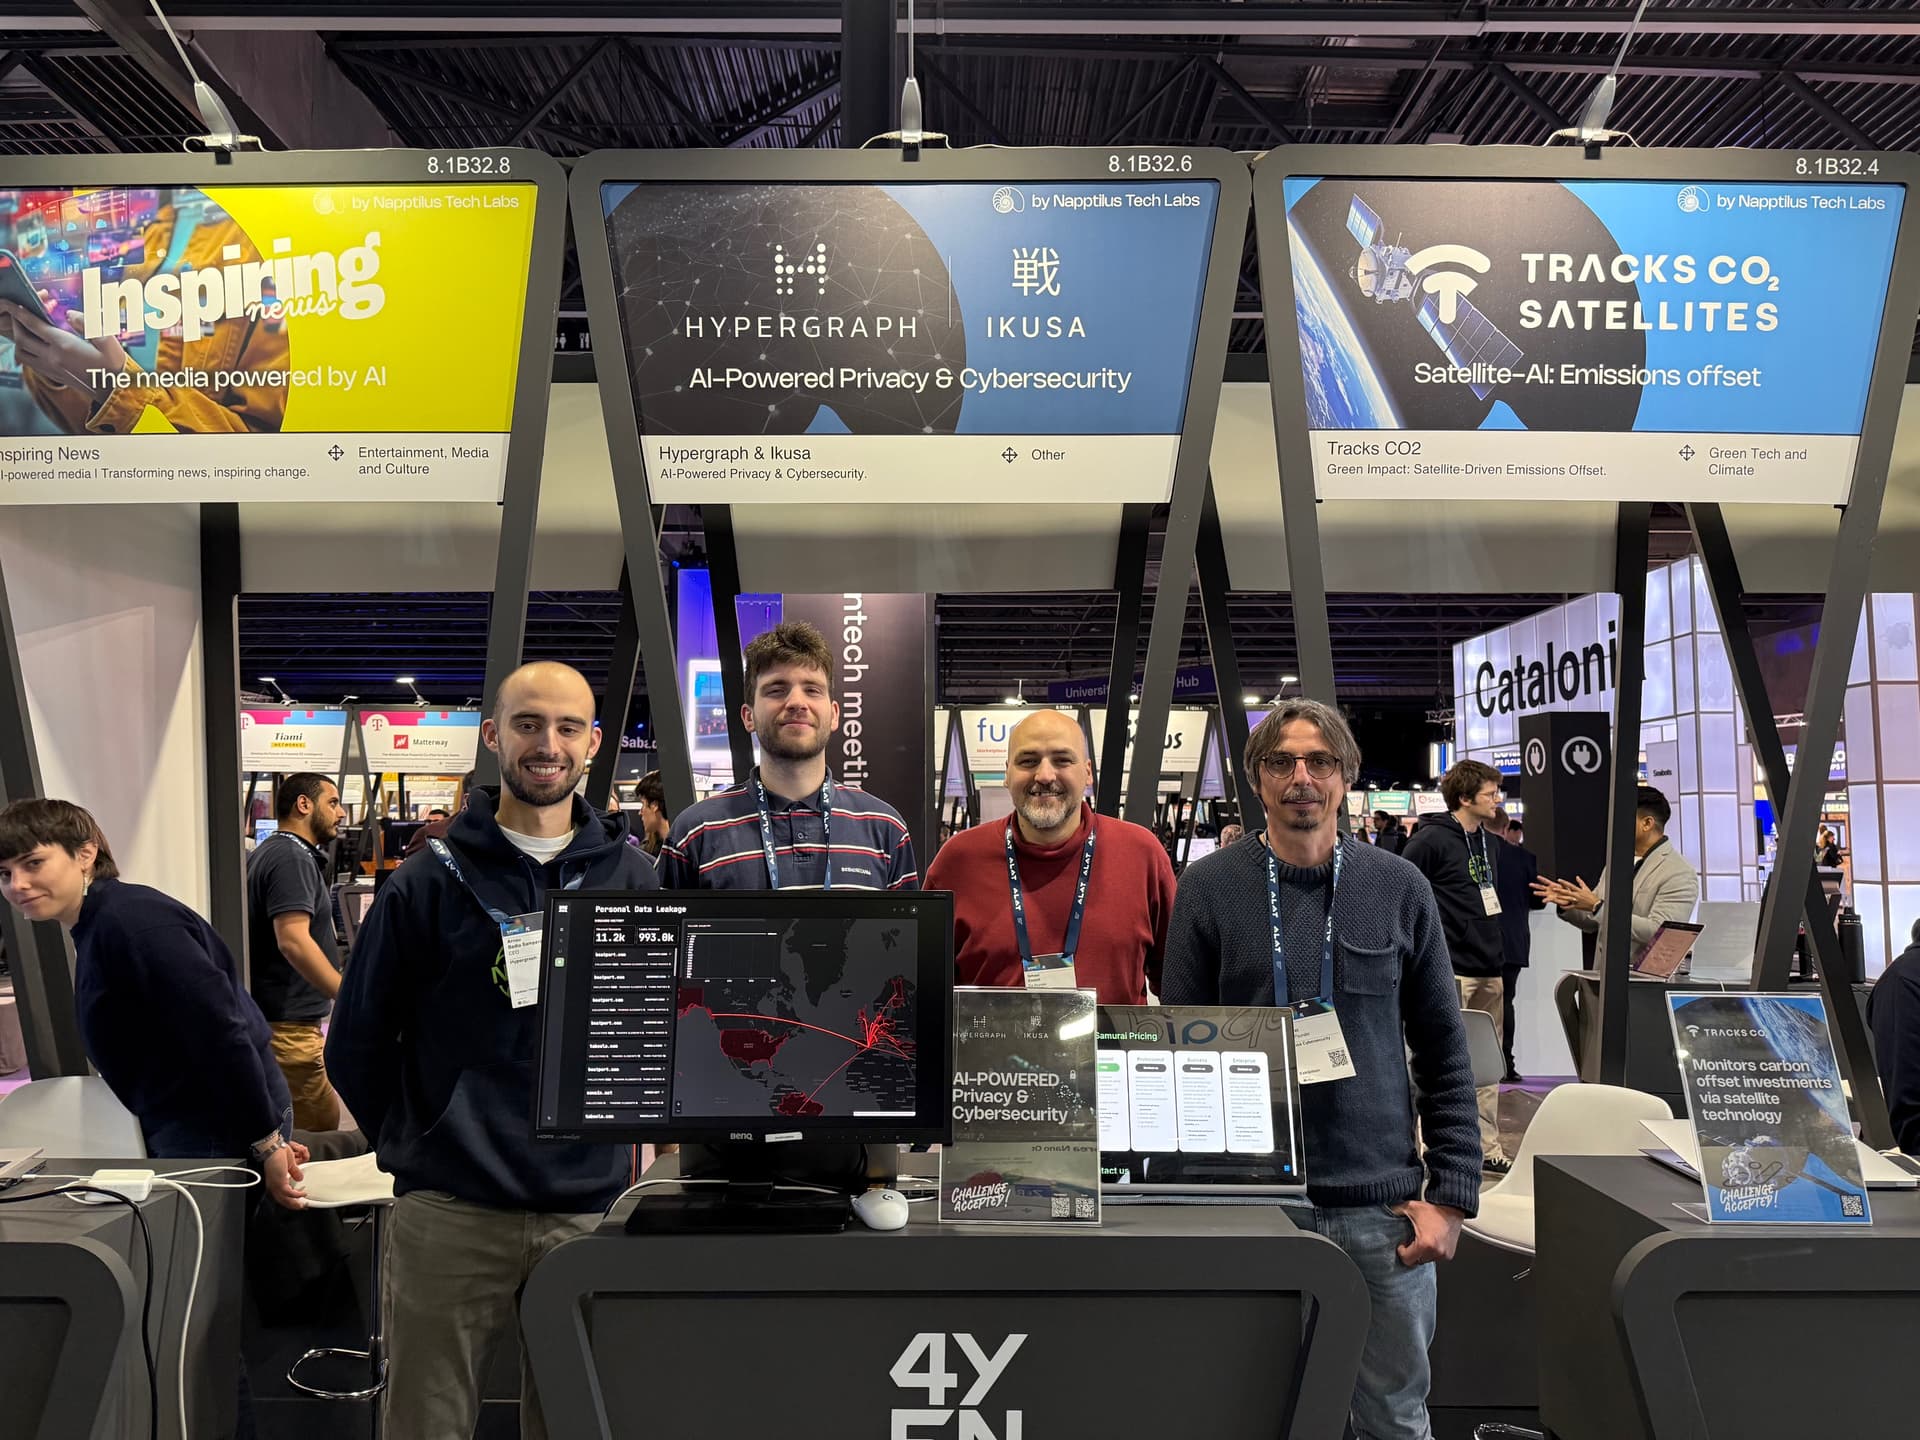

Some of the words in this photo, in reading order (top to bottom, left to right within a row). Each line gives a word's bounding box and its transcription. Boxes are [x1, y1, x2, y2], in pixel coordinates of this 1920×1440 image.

[427, 156, 511, 175] 8.1B32.8
[1108, 154, 1192, 173] 8.1B32.6
[1795, 158, 1879, 176] 8.1B32.4
[352, 195, 371, 211] by
[374, 195, 442, 210] Napptilus
[446, 194, 480, 208] Tech
[483, 194, 519, 208] Labs
[1031, 194, 1049, 210] by
[1053, 194, 1122, 210] Napptilus
[1126, 193, 1160, 207] Tech
[1163, 193, 1200, 207] Labs
[1717, 194, 1735, 210] by
[1738, 194, 1808, 211] Napptilus
[1811, 195, 1846, 210] Tech
[1849, 195, 1885, 210] Labs
[1521, 252, 1696, 284] TRACKS
[83, 231, 385, 342] Inspiring
[245, 290, 337, 323] news
[1519, 299, 1779, 332] SATELLITES
[686, 316, 917, 339] HYPERGRAPH
[987, 316, 1087, 338] IKUSA
[86, 368, 133, 389] The
[136, 368, 209, 389] media
[214, 366, 325, 391] powered
[328, 366, 356, 391] by
[364, 367, 386, 386] AI
[840, 367, 930, 393] Privacy
[935, 370, 953, 389] &
[959, 367, 1132, 393] Cybersecurity
[1560, 363, 1681, 387] Emissions
[1686, 365, 1762, 387] offset
[58, 446, 100, 460] News
[358, 446, 448, 462] Entertainment,
[451, 446, 489, 459] Media
[659, 445, 749, 463] Hypergraph
[754, 446, 765, 460] &
[770, 445, 811, 461] Ikusa
[1031, 448, 1065, 461] Other
[1327, 441, 1379, 457] Tracks
[1384, 441, 1422, 457] CO2
[1709, 447, 1747, 461] Green
[1751, 447, 1779, 461] Tech
[1782, 447, 1807, 461] and
[58, 469, 91, 479] media
[101, 466, 174, 480] Transforming
[177, 468, 211, 478] news,
[214, 467, 261, 479] inspiring
[264, 466, 310, 479] change.
[358, 464, 382, 476] and
[385, 463, 430, 476] Culture
[660, 468, 727, 480] AI-Powered
[730, 468, 771, 482] Privacy
[774, 468, 783, 480] &
[786, 467, 867, 482] Cybersecurity.
[1327, 463, 1363, 476] Green
[1366, 463, 1410, 478] Impact:
[1413, 463, 1502, 477] Satellite-Driven
[1506, 464, 1565, 477] Emissions
[1569, 464, 1606, 477] Offset.
[1708, 463, 1754, 477] Climate
[1477, 619, 1616, 717] Cataloni
[1176, 676, 1199, 688] Hub
[412, 737, 448, 747] Matterway
[1009, 856, 1018, 881] ALAT
[1083, 852, 1092, 876] ALAT
[1013, 887, 1022, 911] ALAT
[1077, 882, 1086, 905] ALAT
[595, 905, 631, 913] Personal
[634, 905, 652, 913] Data
[656, 905, 687, 914] Leakage
[1270, 891, 1279, 918] ALAT
[595, 932, 626, 942] 11.2k
[1273, 926, 1281, 953] ALAT
[1129, 1032, 1158, 1041] Pricing
[1704, 1029, 1747, 1037] TRACKS
[1693, 1059, 1757, 1072] Monitors
[1759, 1059, 1810, 1072] carbon
[1697, 1076, 1741, 1088] offset
[1743, 1077, 1832, 1089] investments
[952, 1089, 1013, 1107] Privacy
[1017, 1090, 1029, 1104] &
[1699, 1093, 1722, 1105] via
[1723, 1092, 1780, 1105] satellite
[952, 1106, 1068, 1125] Cybersecurity
[1702, 1108, 1782, 1124] technology
[952, 1182, 1008, 1203] CHALLENGE
[1720, 1183, 1776, 1204] CHALLENGE
[889, 1333, 1029, 1406] 4Y
